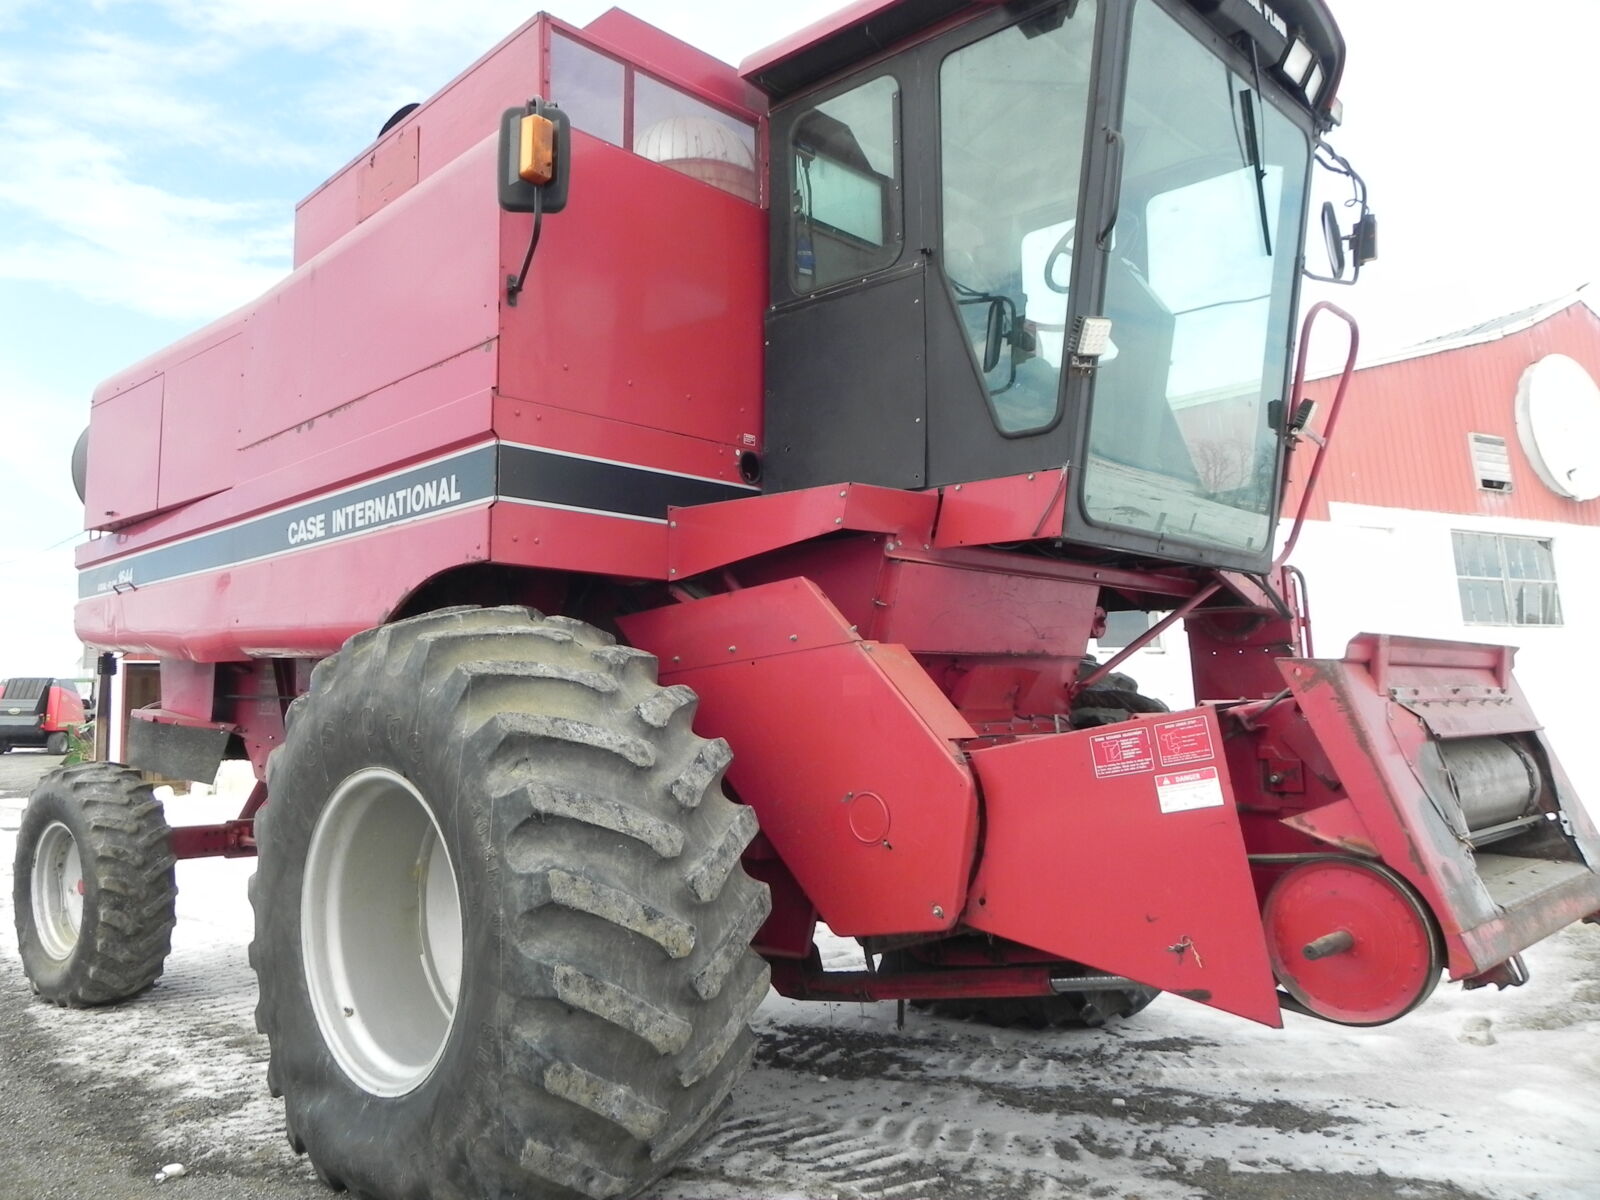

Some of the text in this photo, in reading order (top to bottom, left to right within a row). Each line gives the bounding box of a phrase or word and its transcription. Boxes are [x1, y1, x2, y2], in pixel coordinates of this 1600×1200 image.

[287, 474, 461, 545] CASE INTERNATIONAL
[1175, 772, 1201, 783] DANGER
